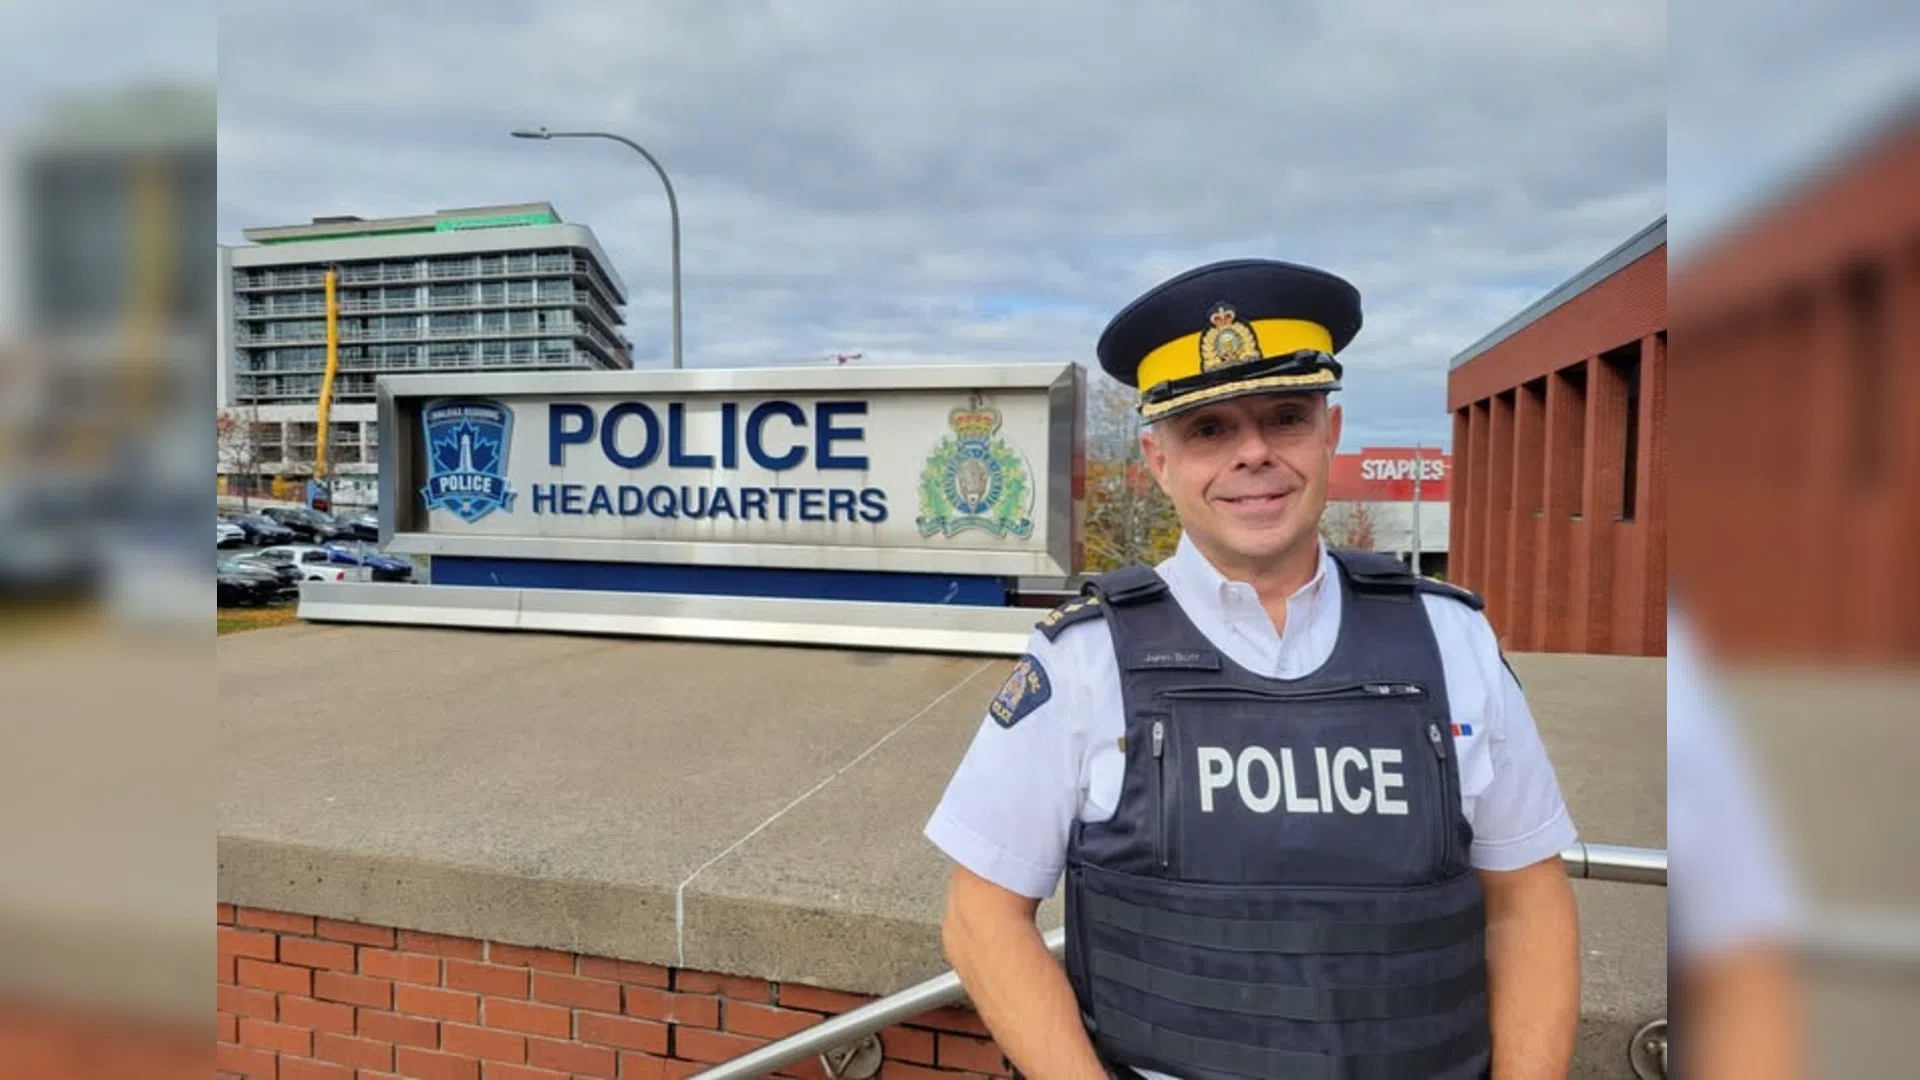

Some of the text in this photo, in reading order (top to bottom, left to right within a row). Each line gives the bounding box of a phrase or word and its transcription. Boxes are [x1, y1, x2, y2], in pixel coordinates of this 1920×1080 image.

[549, 400, 868, 470] POLICE
[440, 475, 492, 492] POLICE
[1361, 459, 1445, 480] STAPLES
[532, 484, 887, 522] HEADQUARTERS
[1197, 745, 1408, 815] POLICE
